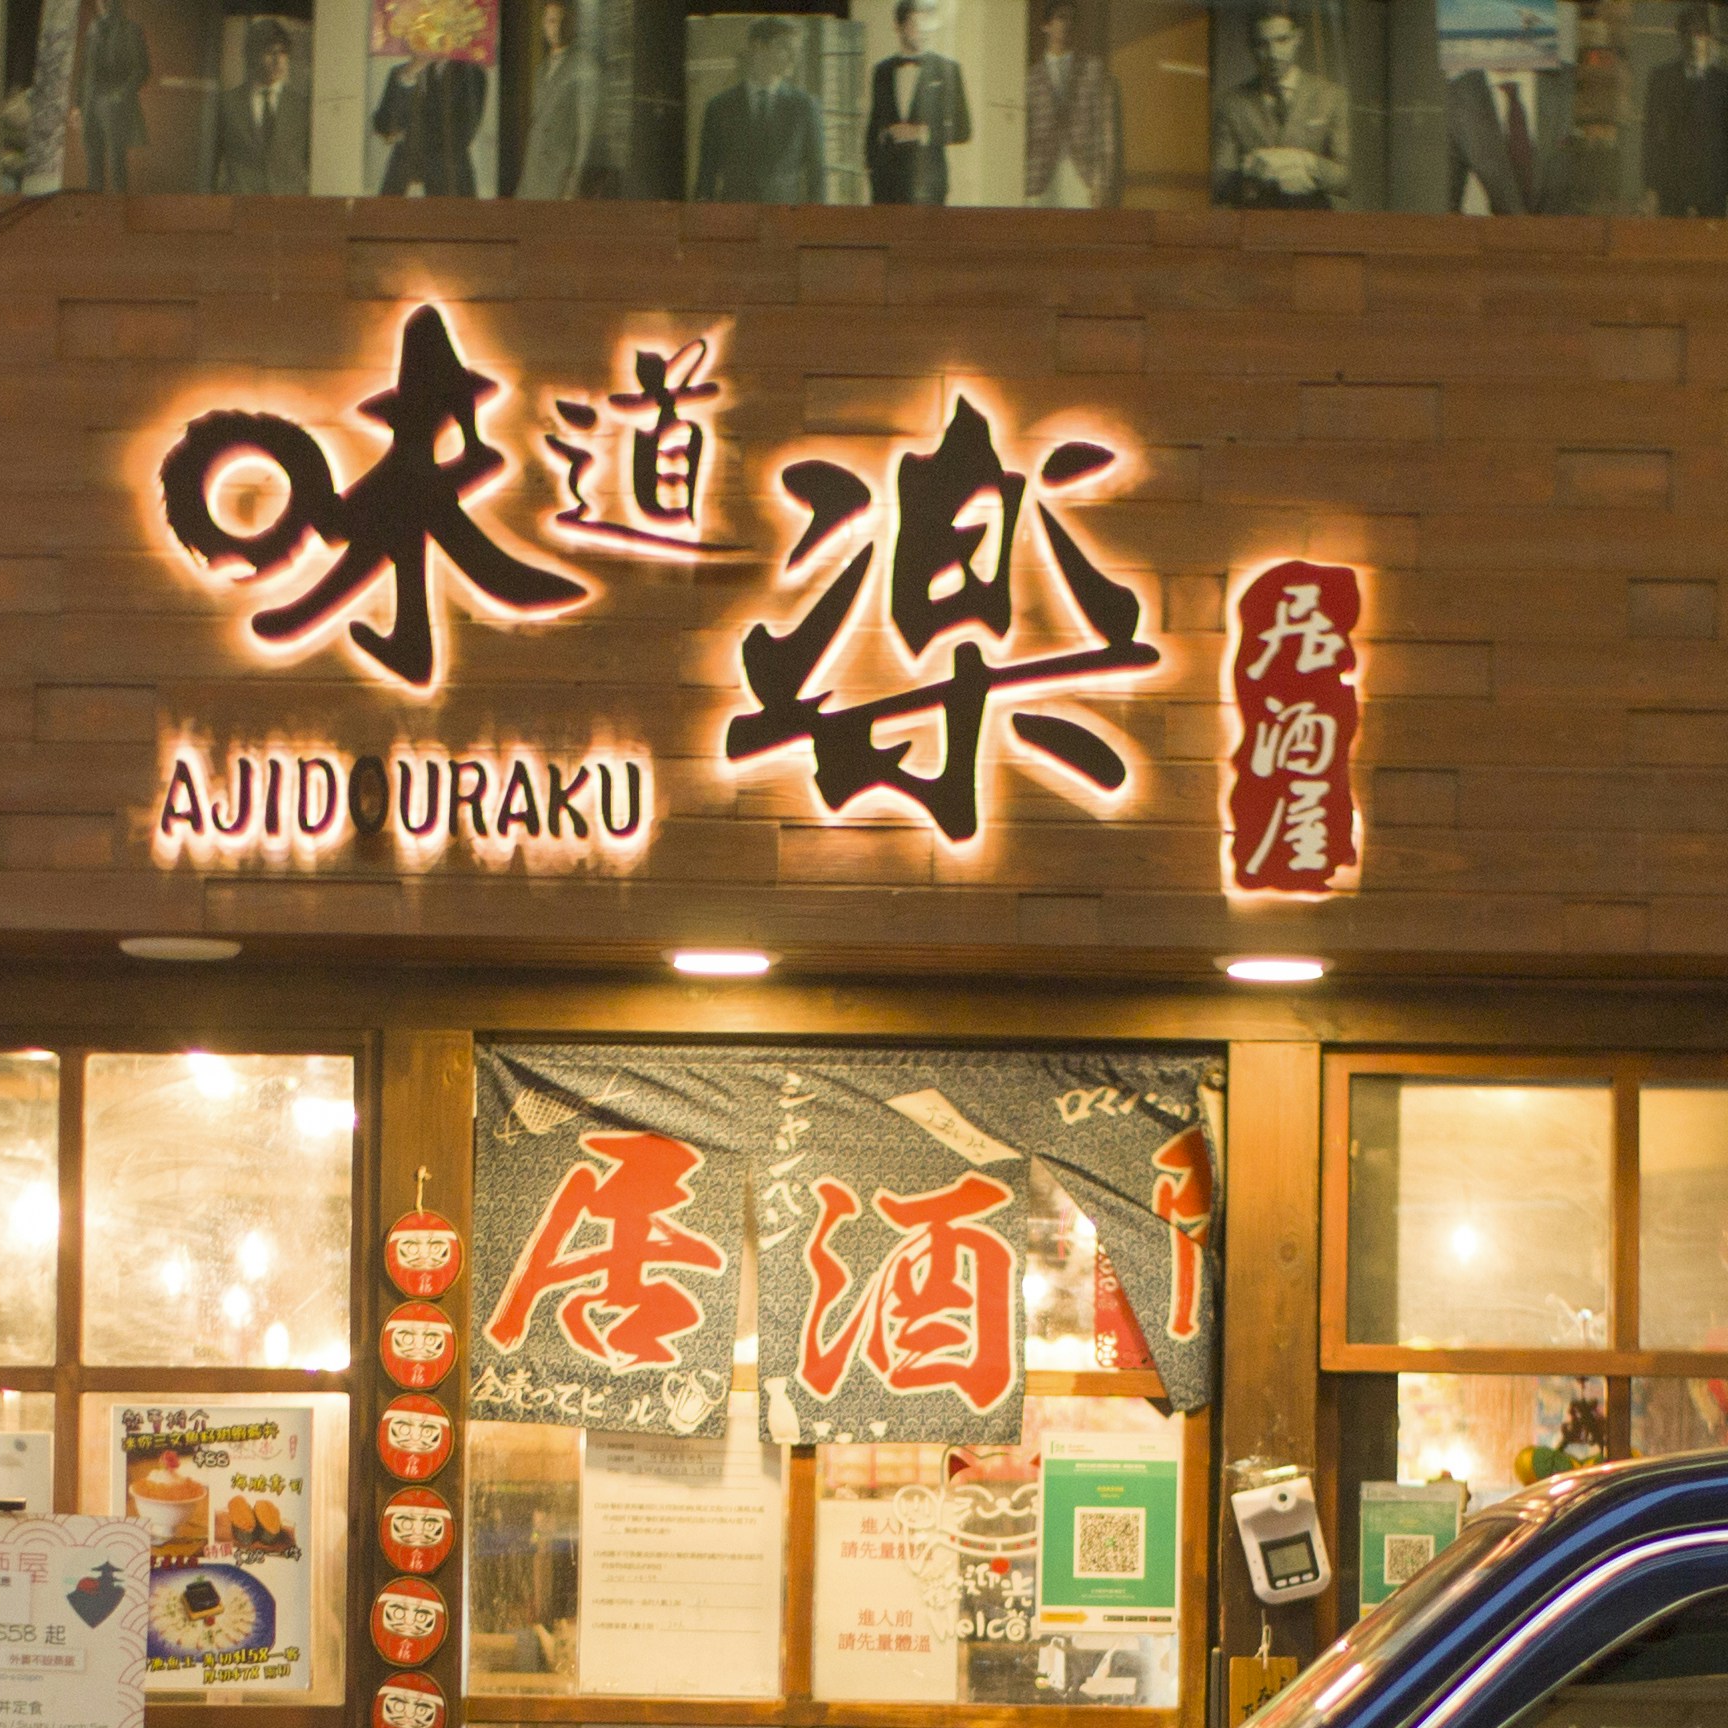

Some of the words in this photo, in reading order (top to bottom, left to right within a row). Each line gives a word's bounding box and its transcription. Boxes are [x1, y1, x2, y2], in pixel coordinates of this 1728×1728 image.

[1244, 581, 1343, 877] 居酒屋
[160, 752, 647, 841] AJIDOURAKU
[857, 1608, 914, 1629] 進入前
[45, 1625, 67, 1646] 起
[837, 1631, 933, 1654] 請先量體溫
